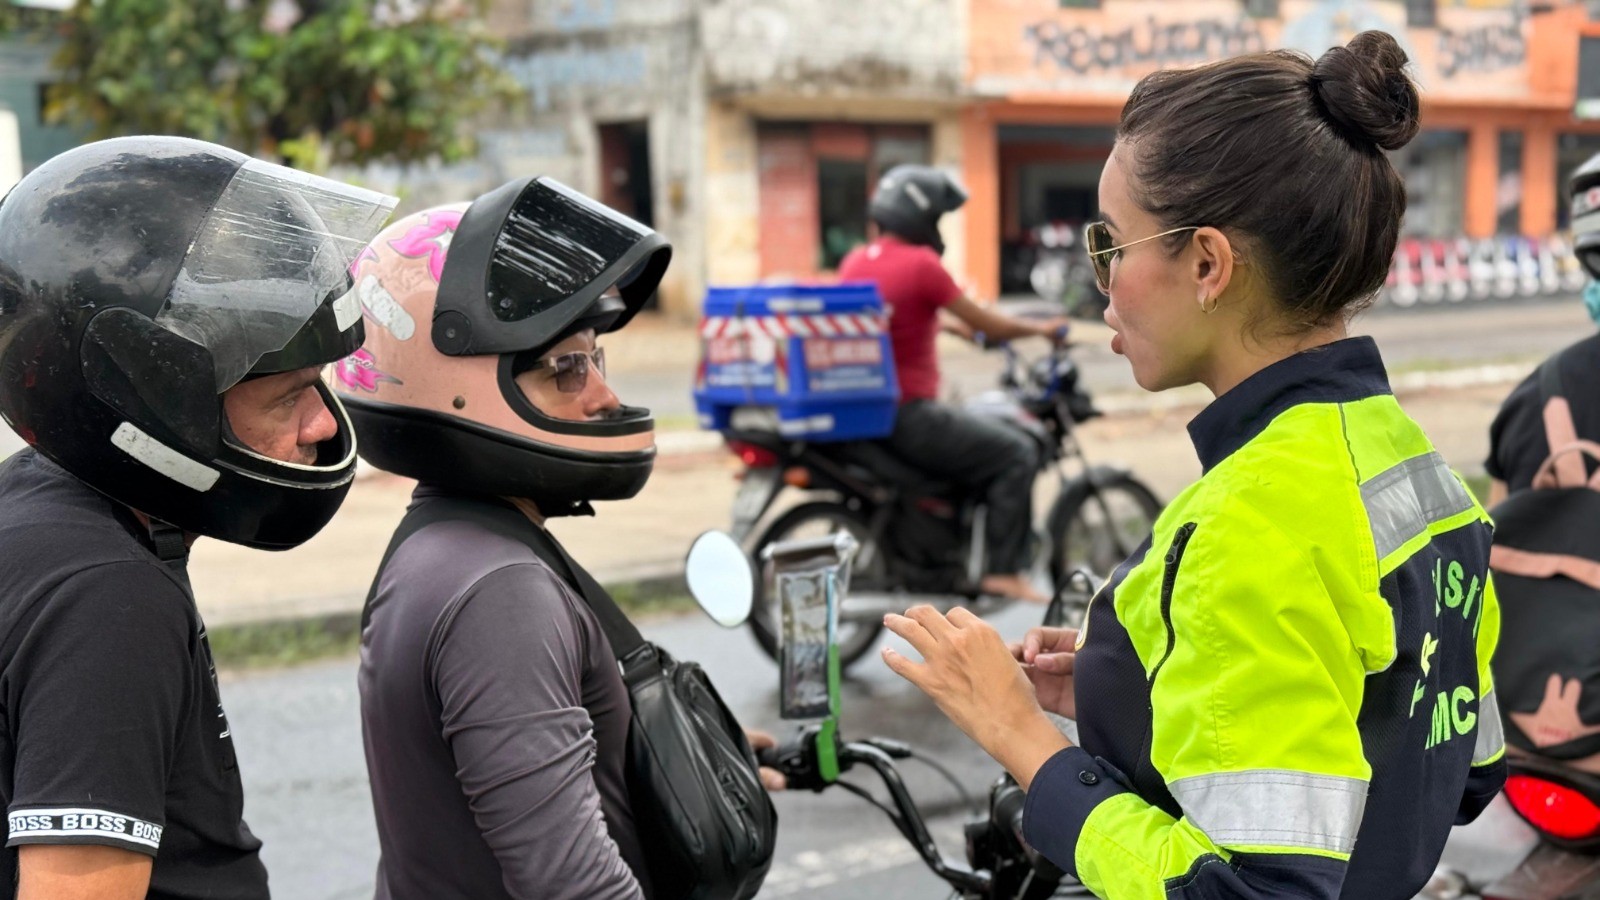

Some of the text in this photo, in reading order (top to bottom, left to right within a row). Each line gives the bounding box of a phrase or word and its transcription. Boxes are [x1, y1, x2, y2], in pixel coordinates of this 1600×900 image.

[1425, 686, 1476, 750] MC
[10, 816, 53, 832] BOSS
[62, 814, 126, 833] BOSS
